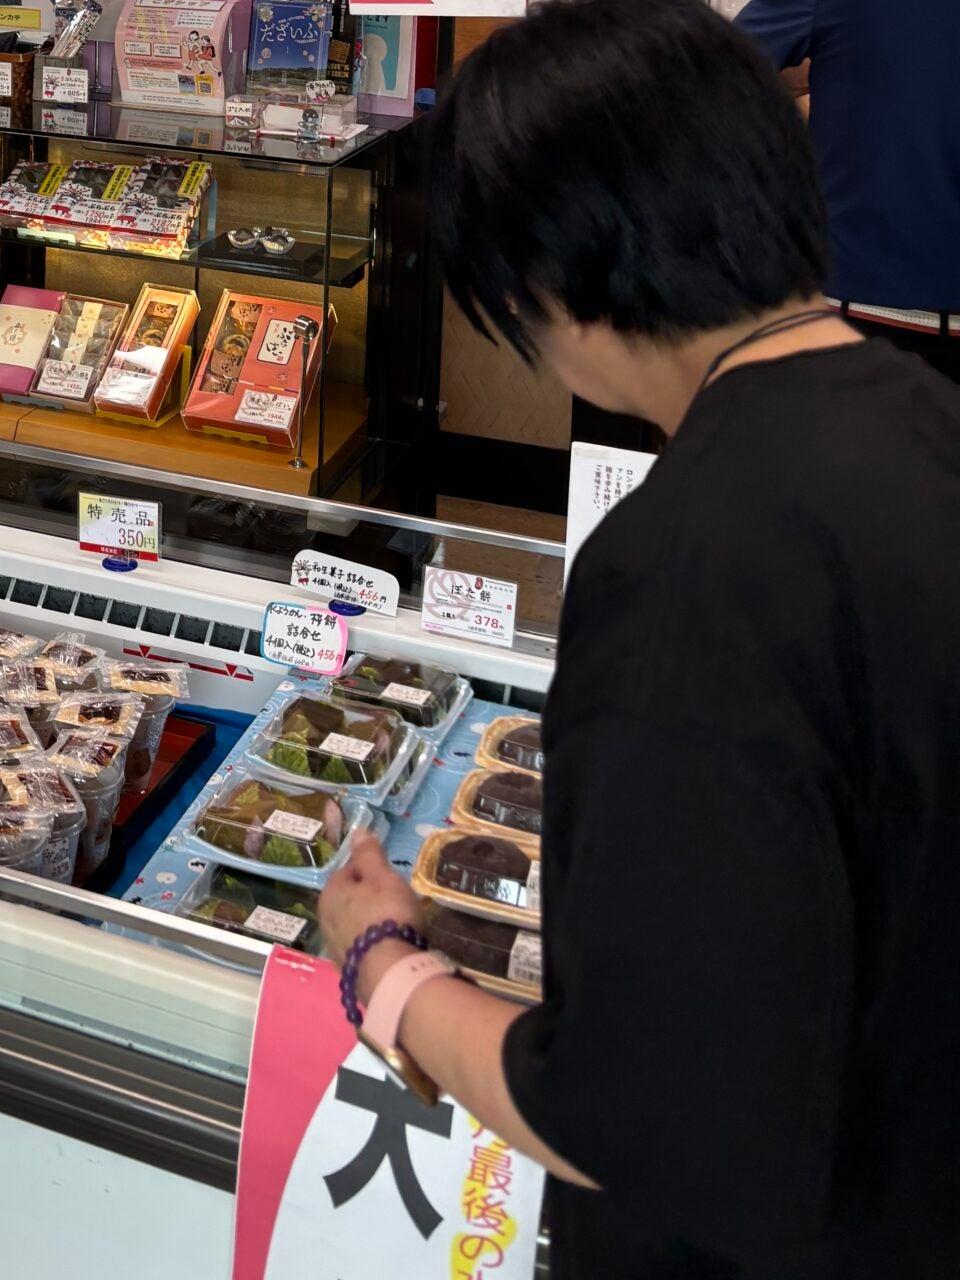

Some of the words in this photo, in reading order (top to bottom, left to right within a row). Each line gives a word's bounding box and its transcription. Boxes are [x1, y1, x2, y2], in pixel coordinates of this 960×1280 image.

[260, 22, 318, 42] だざいふ
[87, 503, 150, 527] 特売品
[118, 527, 155, 549] 350円
[323, 1065, 455, 1242] 大
[458, 1122, 514, 1280] 最後の
